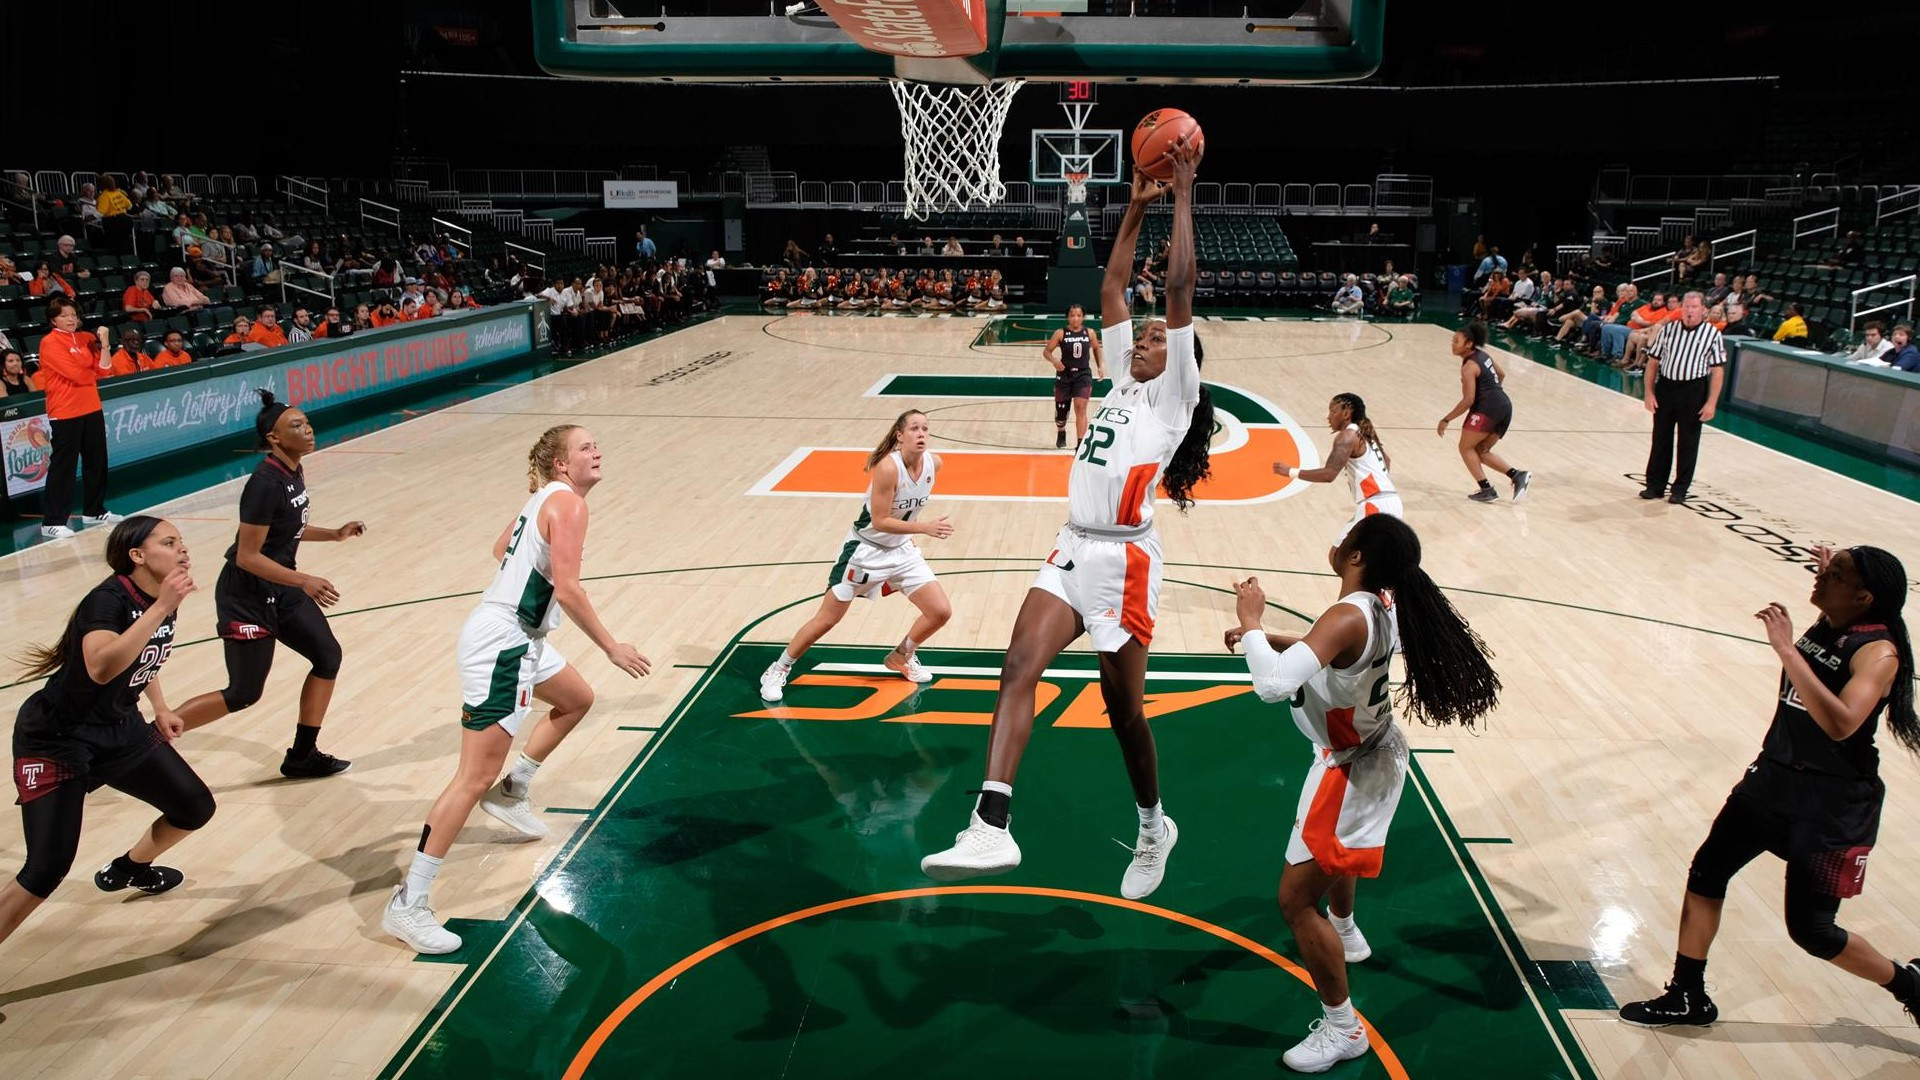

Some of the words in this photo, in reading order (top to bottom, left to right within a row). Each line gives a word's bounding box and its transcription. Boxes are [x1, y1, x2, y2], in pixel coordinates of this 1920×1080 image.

[848, 8, 938, 42] State
[1068, 80, 1090, 99] 30
[1066, 236, 1086, 249] U
[1073, 342, 1083, 359] 0
[111, 398, 178, 443] Florida
[177, 387, 236, 425] Lottery
[286, 350, 379, 406] BRIGHT
[383, 331, 469, 382] FUTURES
[473, 317, 524, 351] scholarships
[1078, 423, 1116, 467] 32
[846, 568, 870, 585] U
[129, 644, 173, 687] 25
[1795, 635, 1842, 672] EMPLE
[22, 763, 44, 789] T
